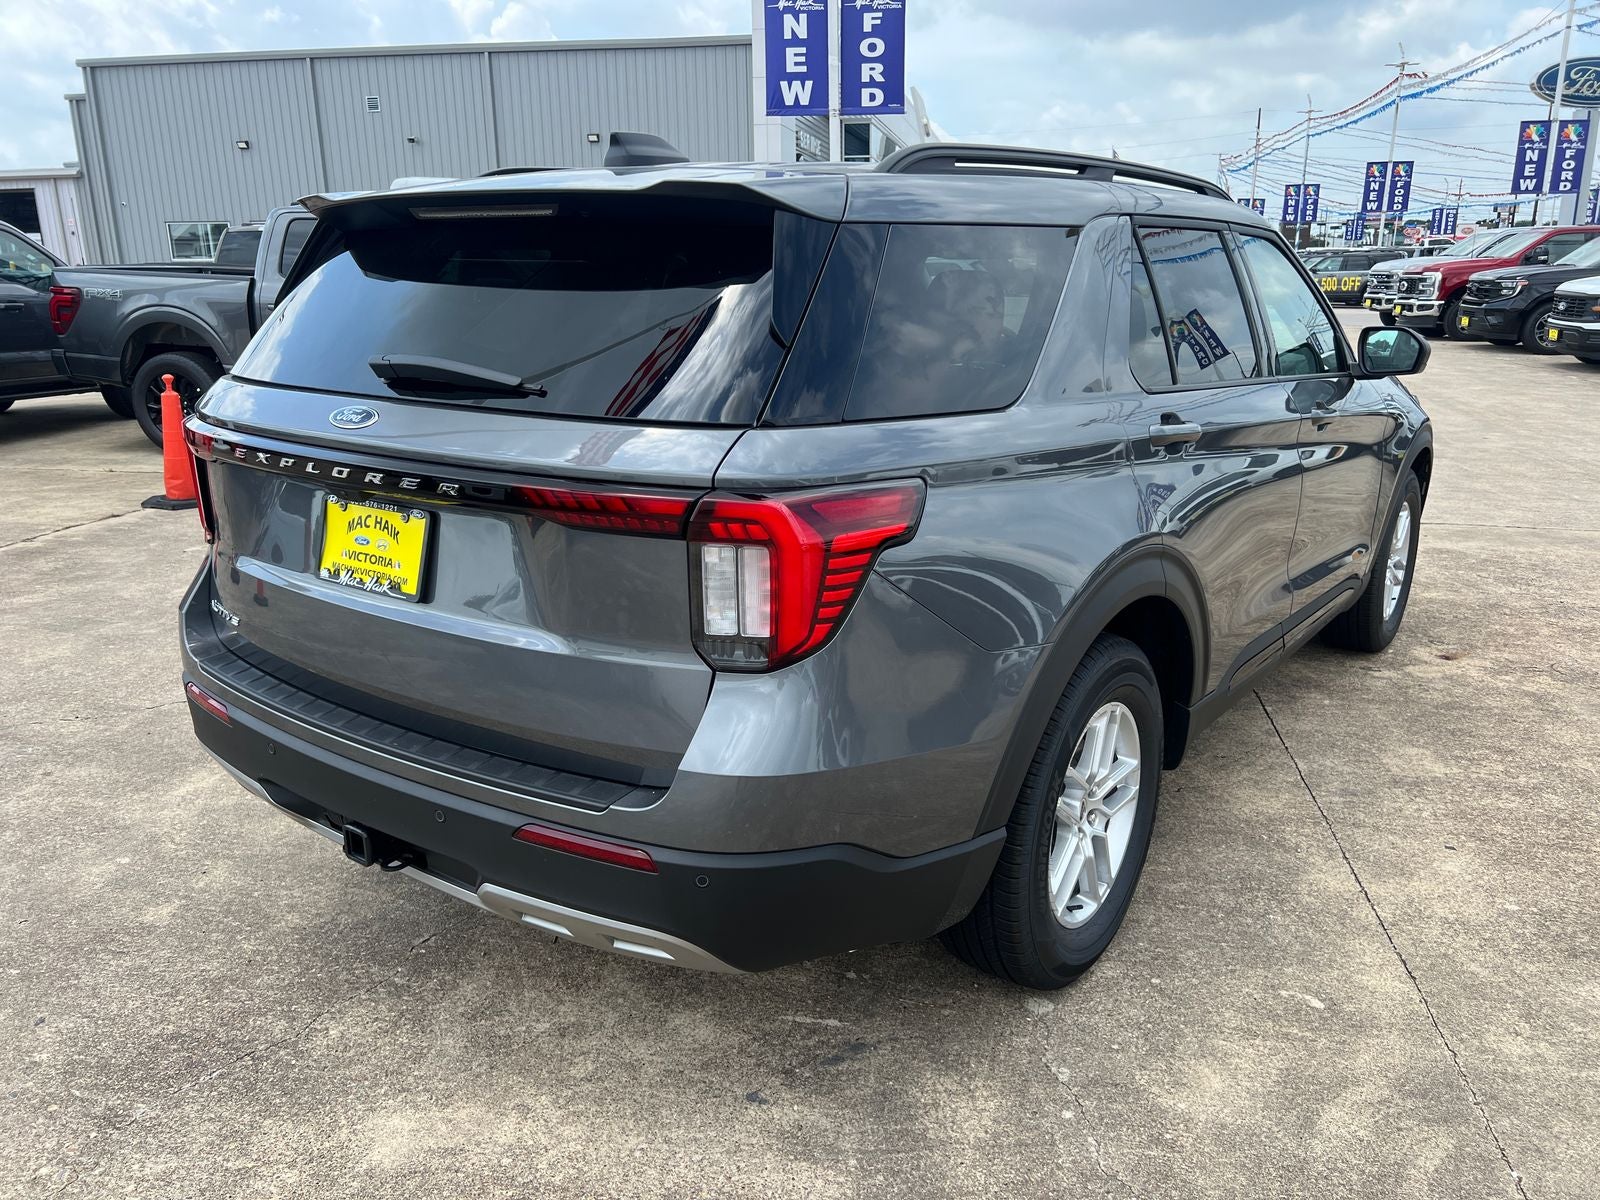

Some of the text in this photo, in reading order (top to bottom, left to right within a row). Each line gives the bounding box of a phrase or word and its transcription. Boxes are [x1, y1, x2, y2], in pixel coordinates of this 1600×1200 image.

[779, 13, 813, 106] NEW
[859, 12, 886, 107] FORD
[1519, 149, 1540, 191] NEW
[1559, 149, 1576, 191] FORD
[1286, 199, 1295, 221] NEW
[1305, 199, 1314, 221] FORD
[1366, 182, 1379, 210] NEW
[1393, 181, 1405, 211] FORD
[1341, 276, 1361, 292] OFF
[233, 448, 461, 497] EXPLORER
[346, 514, 400, 545] MAC HAIK
[347, 549, 394, 569] VICTORIA
